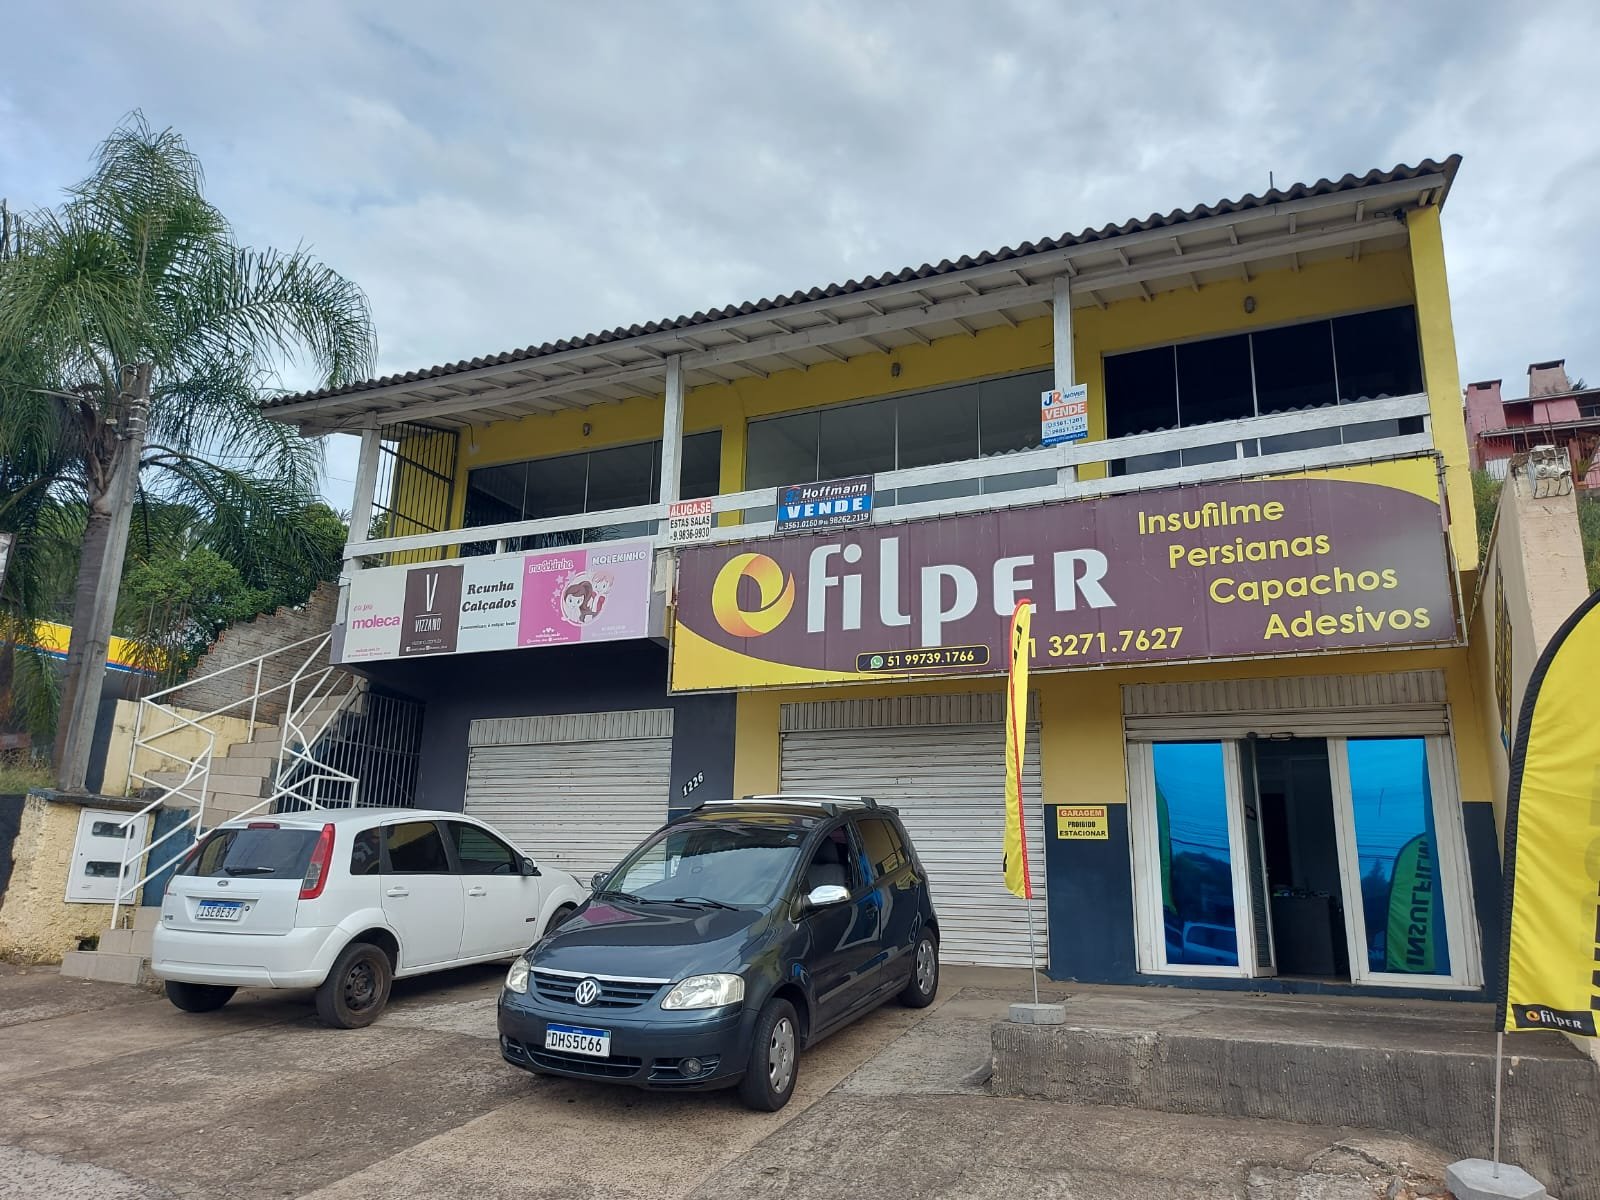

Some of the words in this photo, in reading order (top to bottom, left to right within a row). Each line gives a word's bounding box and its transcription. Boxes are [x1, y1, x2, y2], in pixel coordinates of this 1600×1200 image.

[1045, 403, 1085, 420] VENDE
[802, 483, 867, 499] Hoffmann
[670, 501, 711, 517] ALUGA-SE
[787, 497, 863, 519] VENDE
[670, 518, 689, 528] ESTAS
[690, 515, 710, 526] SALAS
[1138, 500, 1285, 535] Insufilme
[591, 551, 647, 566] MOLEKINHO
[1169, 533, 1331, 569] Persianas
[1209, 567, 1399, 606] Capachos
[462, 597, 518, 613] Calçados
[352, 614, 401, 629] moleca
[415, 617, 442, 633] VIZZANO
[1264, 605, 1431, 640] Adesivos
[1048, 626, 1184, 658] 3271.7627
[887, 655, 900, 667] 51
[905, 650, 975, 665] 99739.1766
[683, 772, 704, 797] 1226
[1061, 809, 1103, 817] GARAGEM
[551, 1032, 602, 1052] DHS5C66
